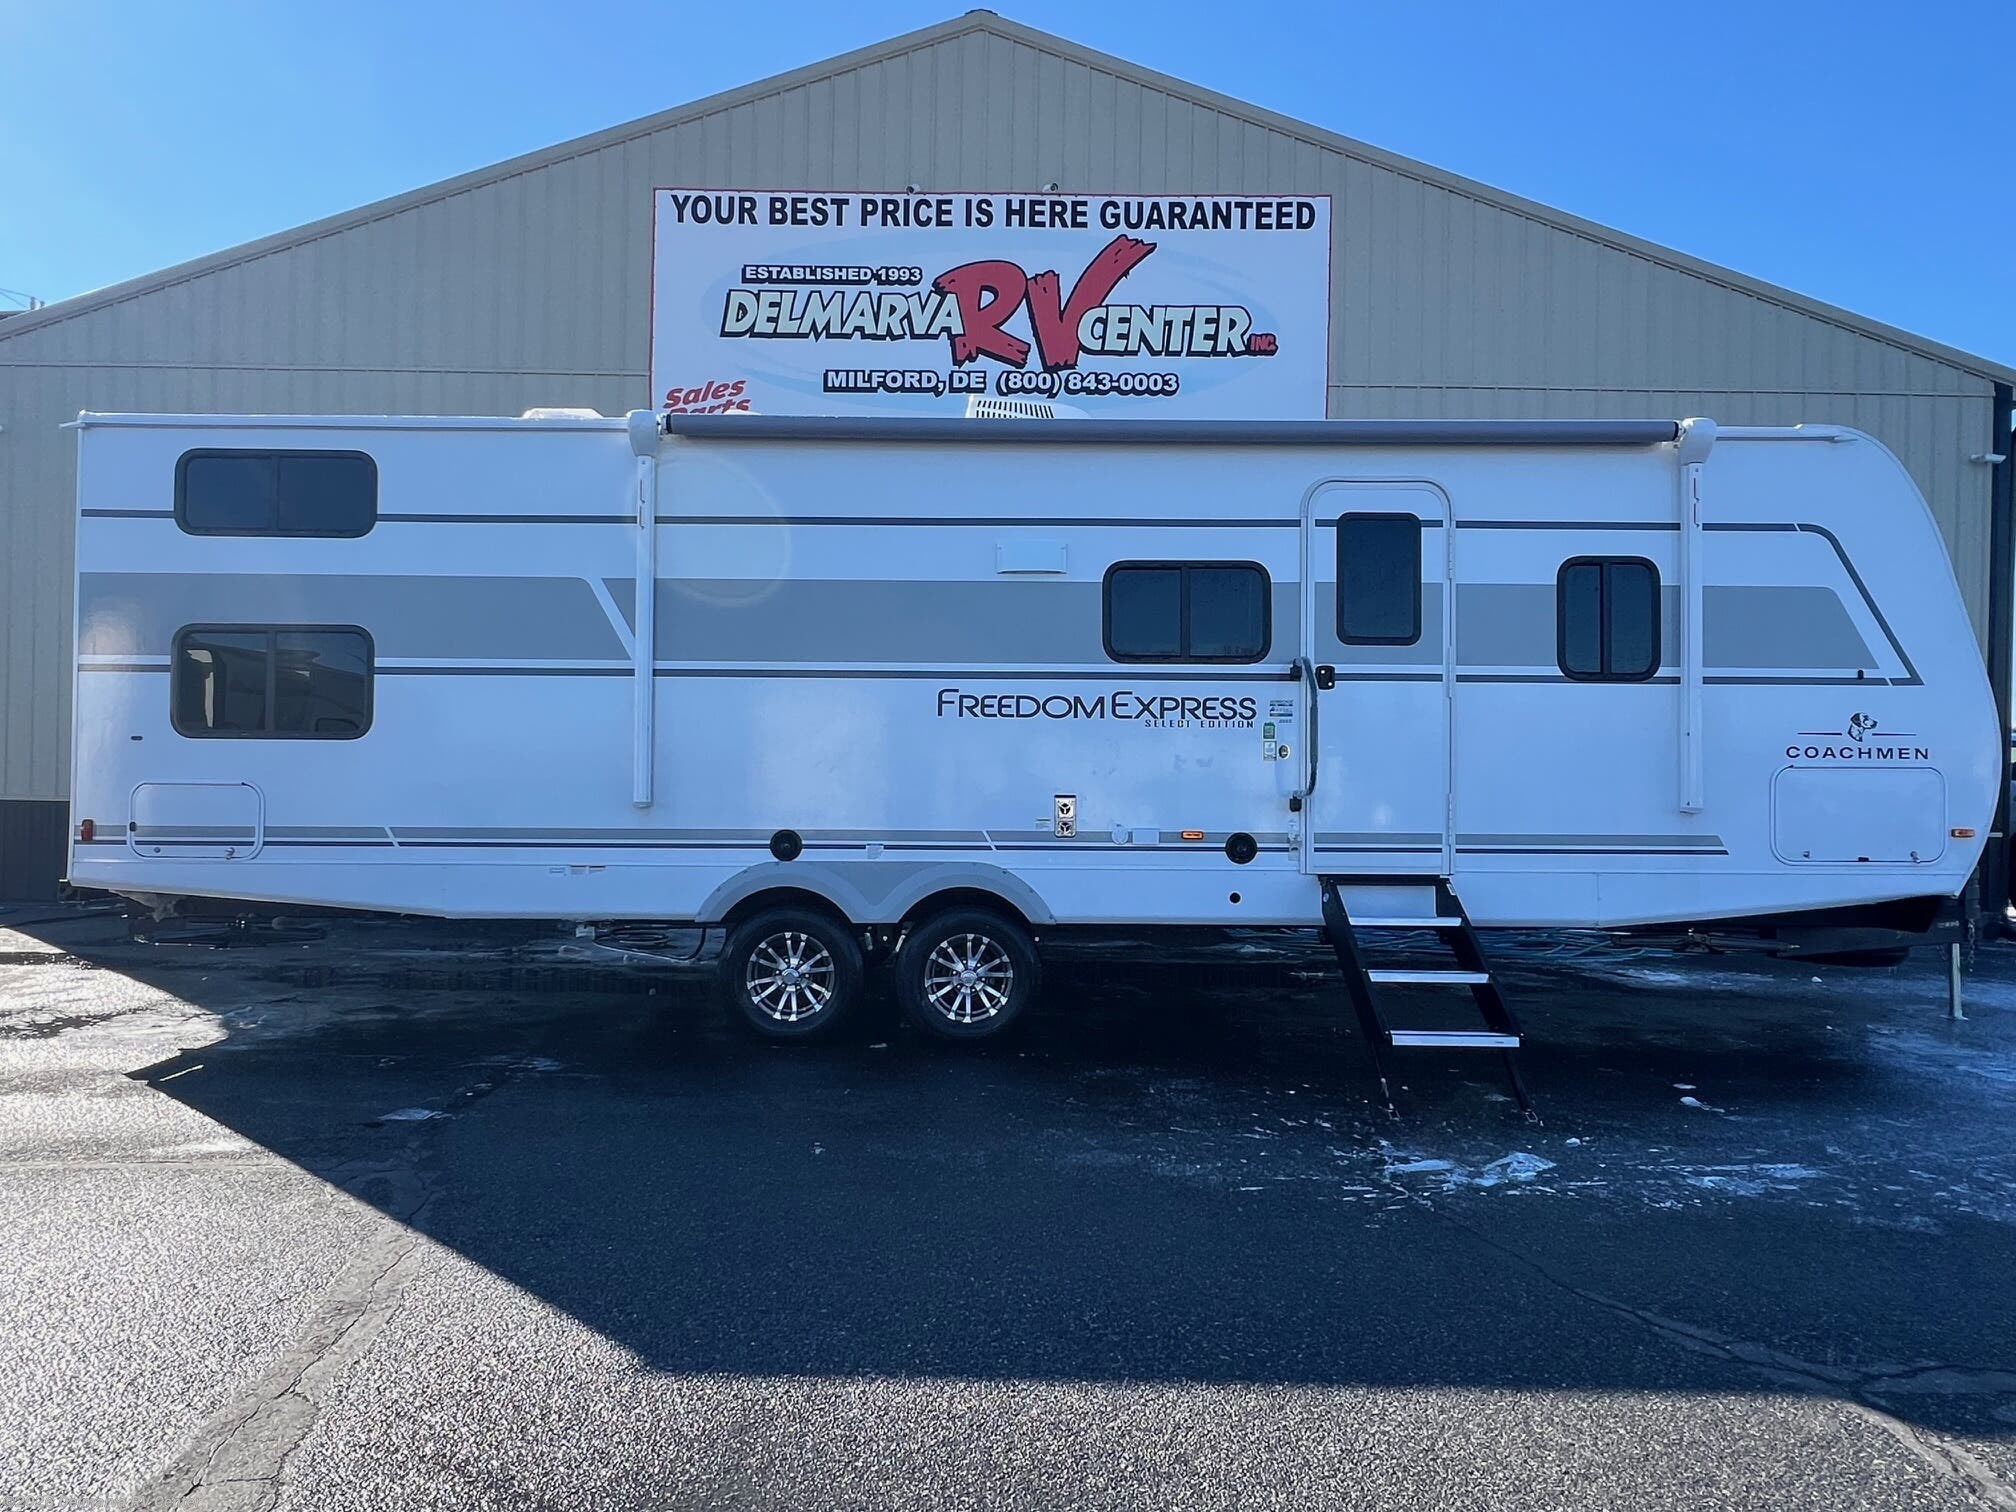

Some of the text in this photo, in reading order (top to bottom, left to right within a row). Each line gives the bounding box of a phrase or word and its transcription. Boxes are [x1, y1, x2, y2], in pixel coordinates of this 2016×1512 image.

[671, 195, 1316, 230] YOUR BEST PRICE IS HERE GUARANTEED
[743, 265, 922, 284] ESTABLISHED 1993
[720, 289, 966, 341] DELMARVA
[932, 234, 1158, 371] RV
[1076, 304, 1252, 357] CENTER
[663, 380, 747, 409] Sales
[825, 370, 1180, 398] MILFORD, DE (800) 843-0003
[1144, 719, 1254, 729] SELECT EDITION
[1785, 746, 1930, 760] COACHMEN
